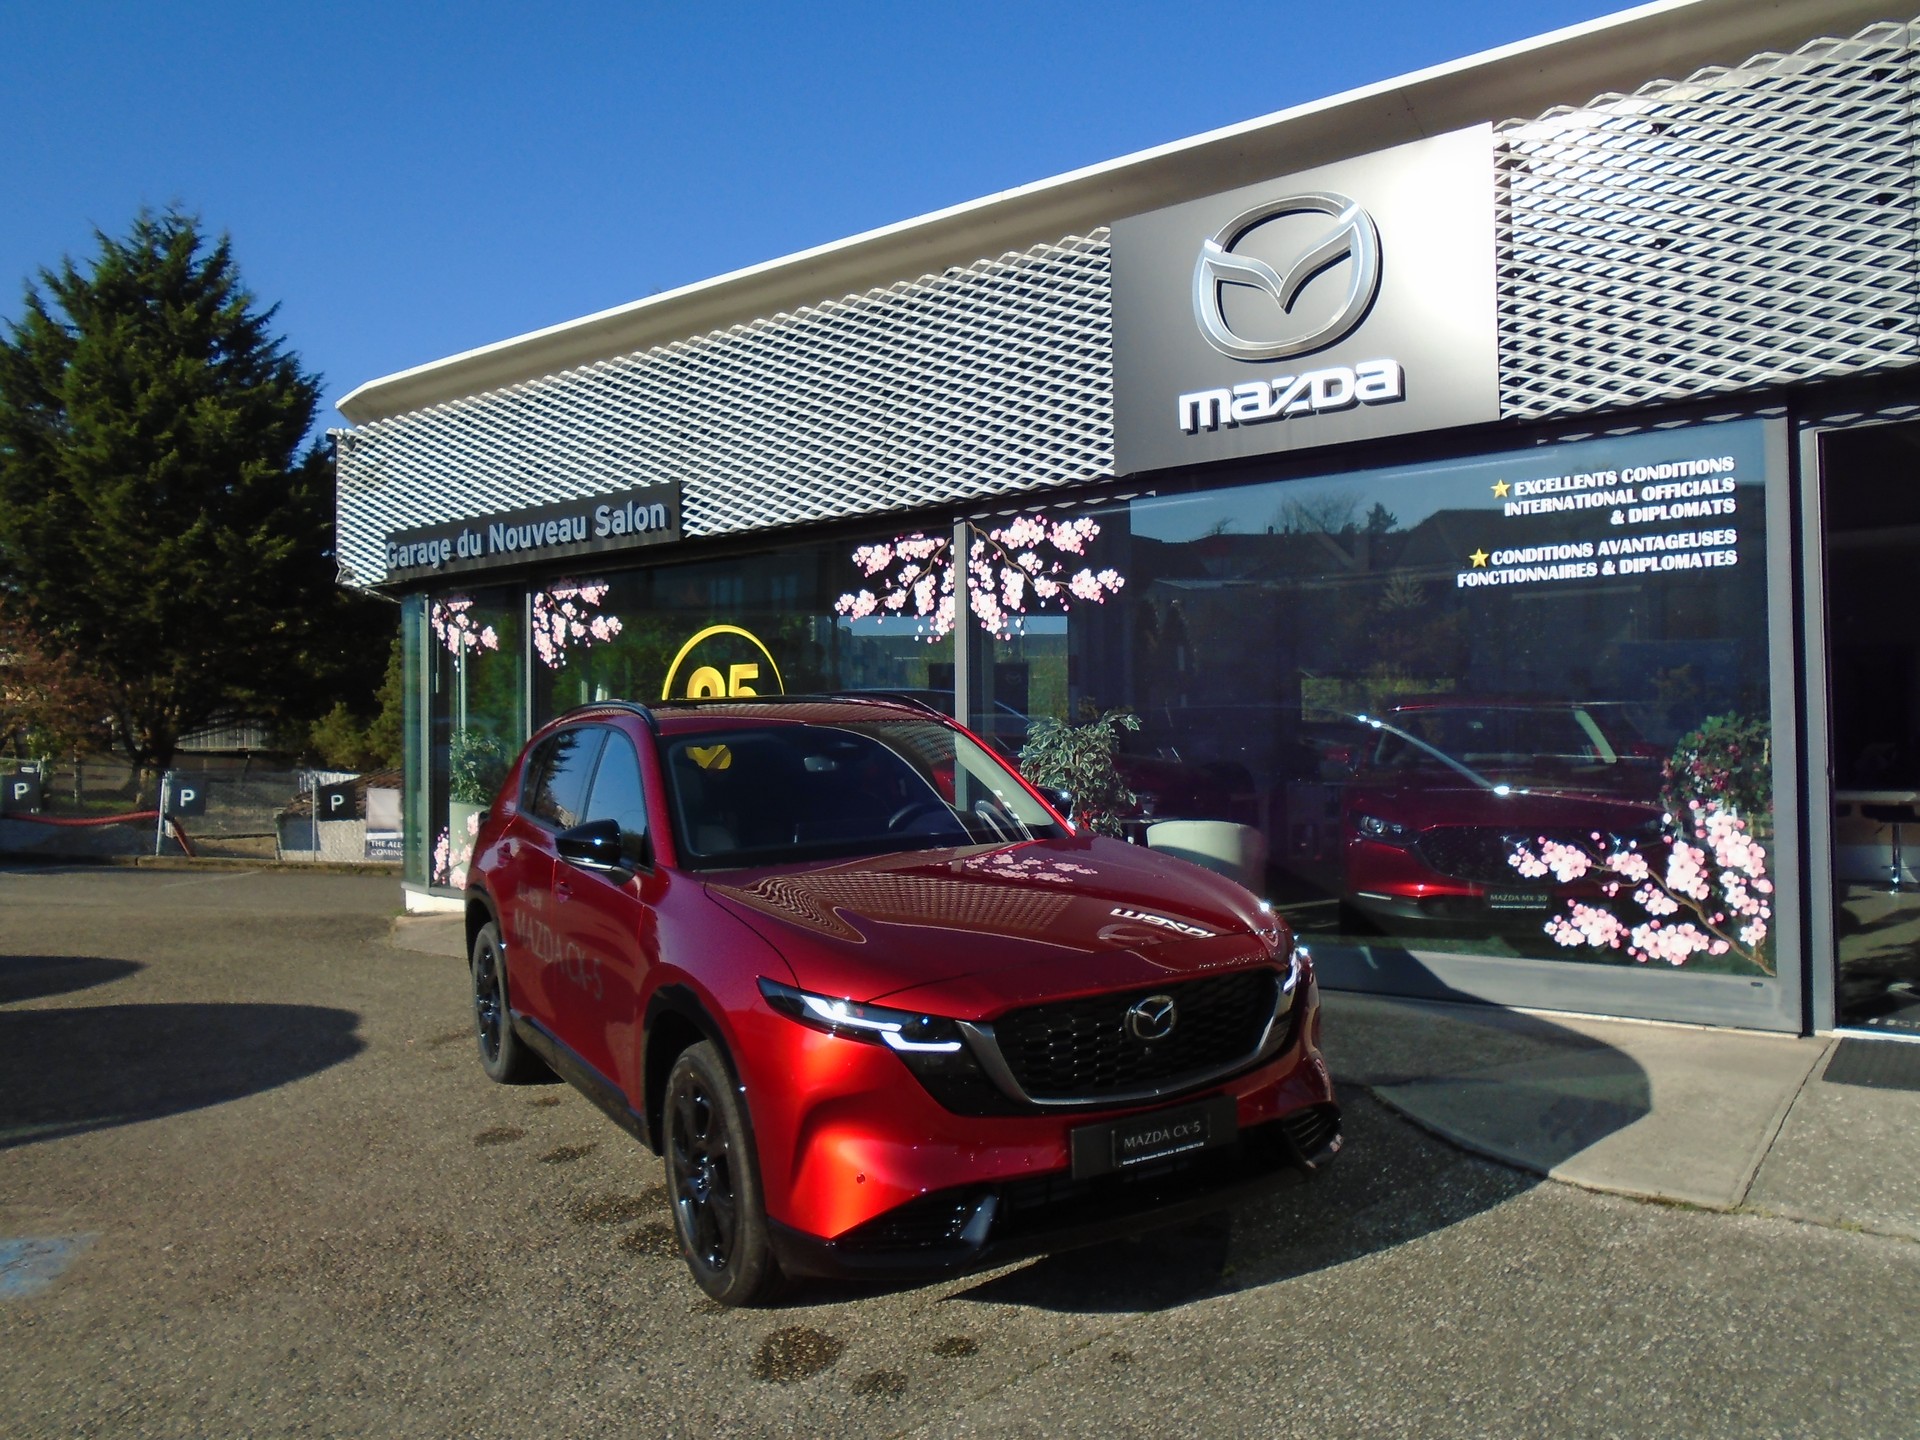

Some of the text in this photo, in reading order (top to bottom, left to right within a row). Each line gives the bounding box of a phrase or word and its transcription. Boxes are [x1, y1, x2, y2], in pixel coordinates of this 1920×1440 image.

[1514, 456, 1735, 497] EXCELLENTS CONDITIONS
[1504, 477, 1735, 517] INTERNATIONAL OFFICIALS
[1610, 498, 1736, 525] & DIPLOMATS
[386, 500, 666, 569] Garage du Nouveau Salon
[1491, 529, 1737, 566] CONDITIONS AVANTAGEUSES
[1457, 550, 1738, 588] FONCTIONNAIRES & DIPLOMATES
[14, 782, 29, 800] P
[179, 789, 195, 807] P
[330, 794, 344, 811] P
[1489, 894, 1520, 902] MAZDA
[513, 908, 564, 974] MAZDA
[1124, 1129, 1170, 1149] MAZDA
[1173, 1121, 1201, 1138] CX-5
